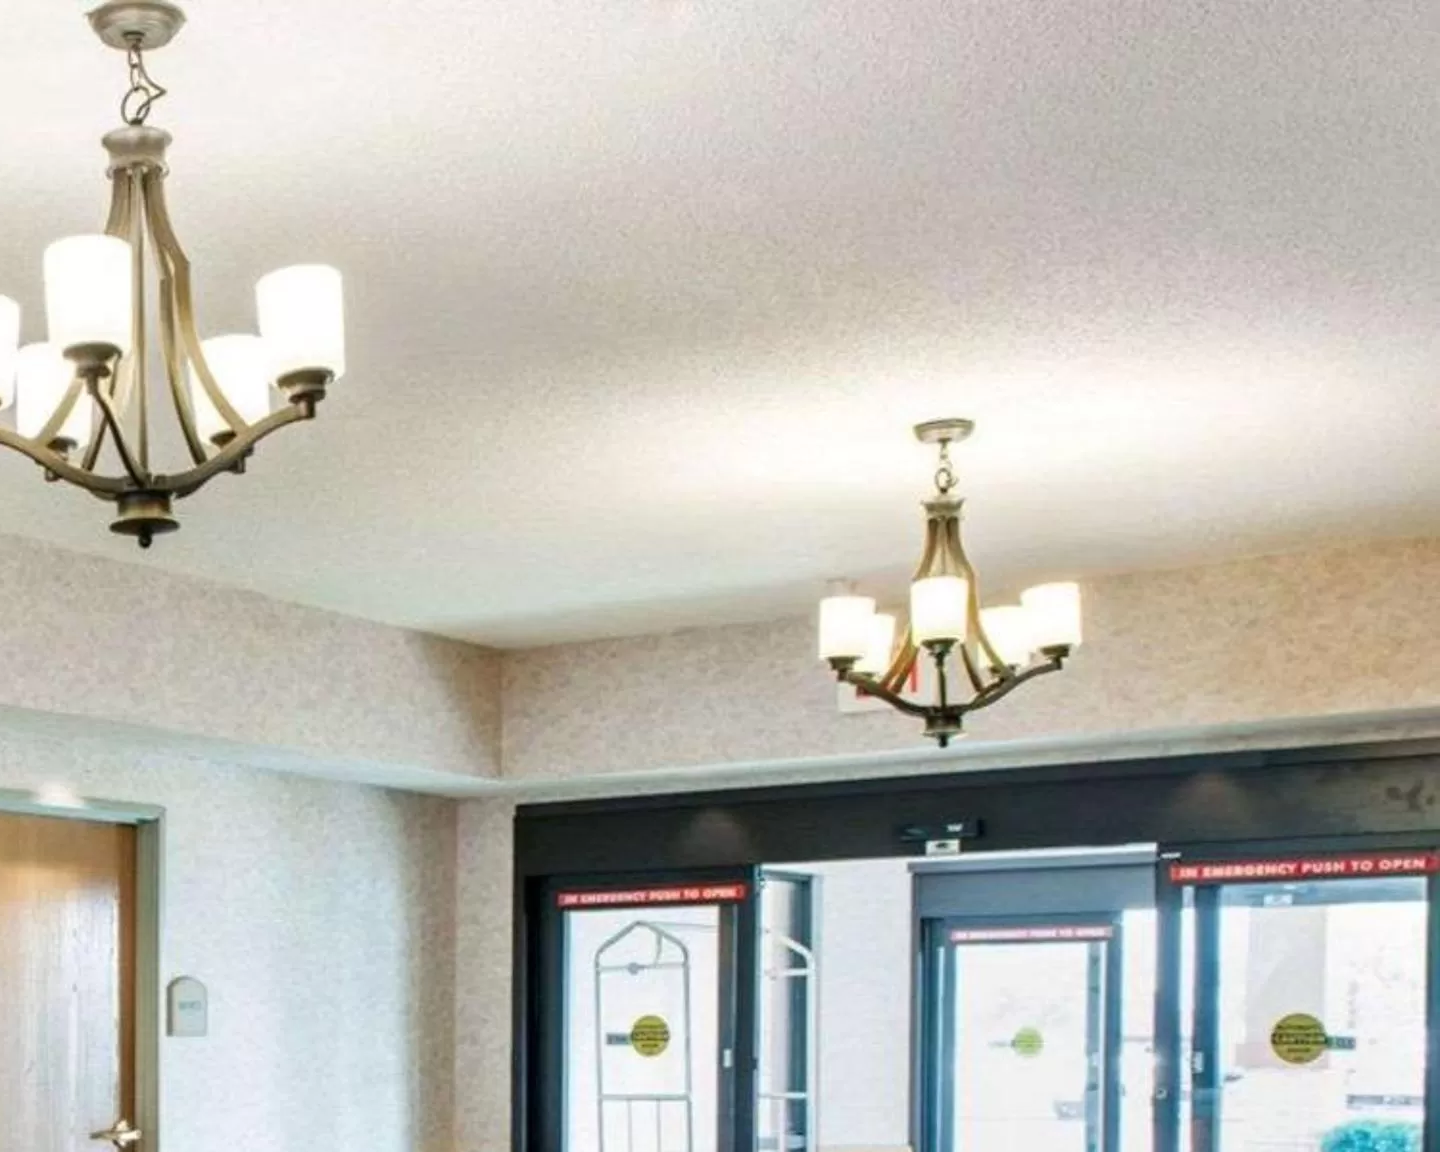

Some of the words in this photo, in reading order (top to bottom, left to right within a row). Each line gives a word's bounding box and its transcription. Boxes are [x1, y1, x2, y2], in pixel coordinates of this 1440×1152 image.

[1179, 867, 1197, 879] IN
[1201, 863, 1297, 879] EMERGENCY
[1302, 861, 1345, 874] PUSH
[1350, 860, 1373, 872] TO
[1379, 858, 1426, 871] OPEN
[684, 887, 699, 899] TO
